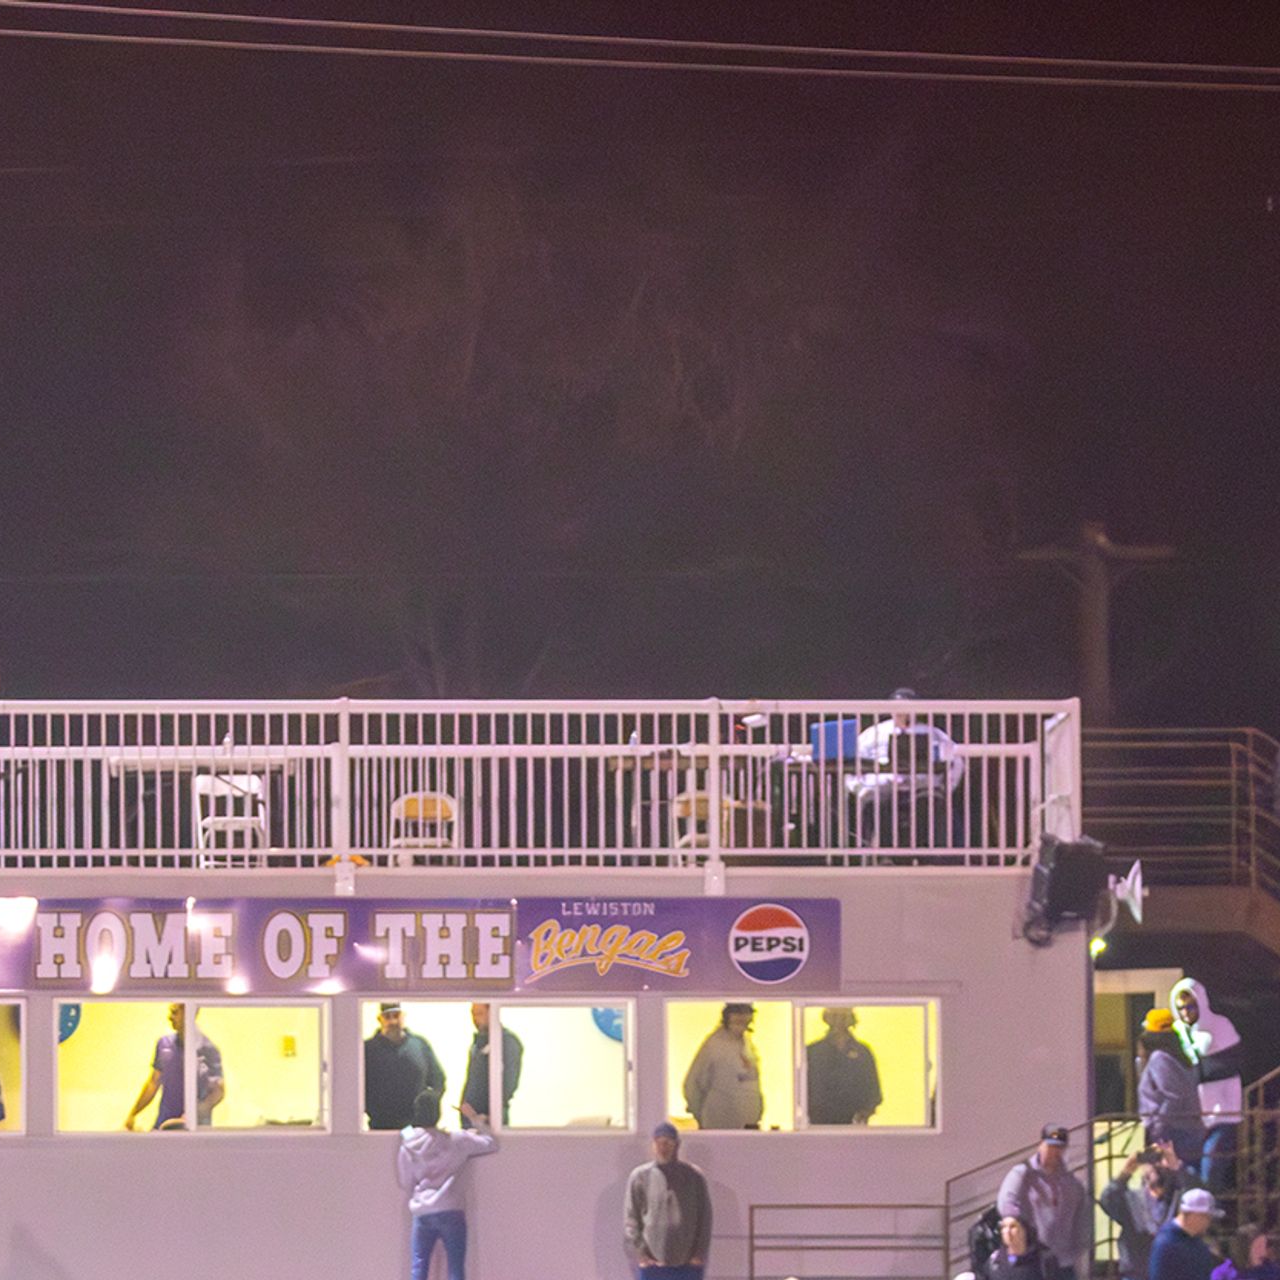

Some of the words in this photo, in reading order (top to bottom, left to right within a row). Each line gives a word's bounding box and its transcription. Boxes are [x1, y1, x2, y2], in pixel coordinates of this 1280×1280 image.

[560, 901, 656, 917] LEWISTON
[36, 911, 234, 979] HOME
[263, 911, 346, 979] OF
[374, 911, 512, 979] THE
[528, 918, 692, 978] Bengals
[733, 935, 806, 953] PEPSI
